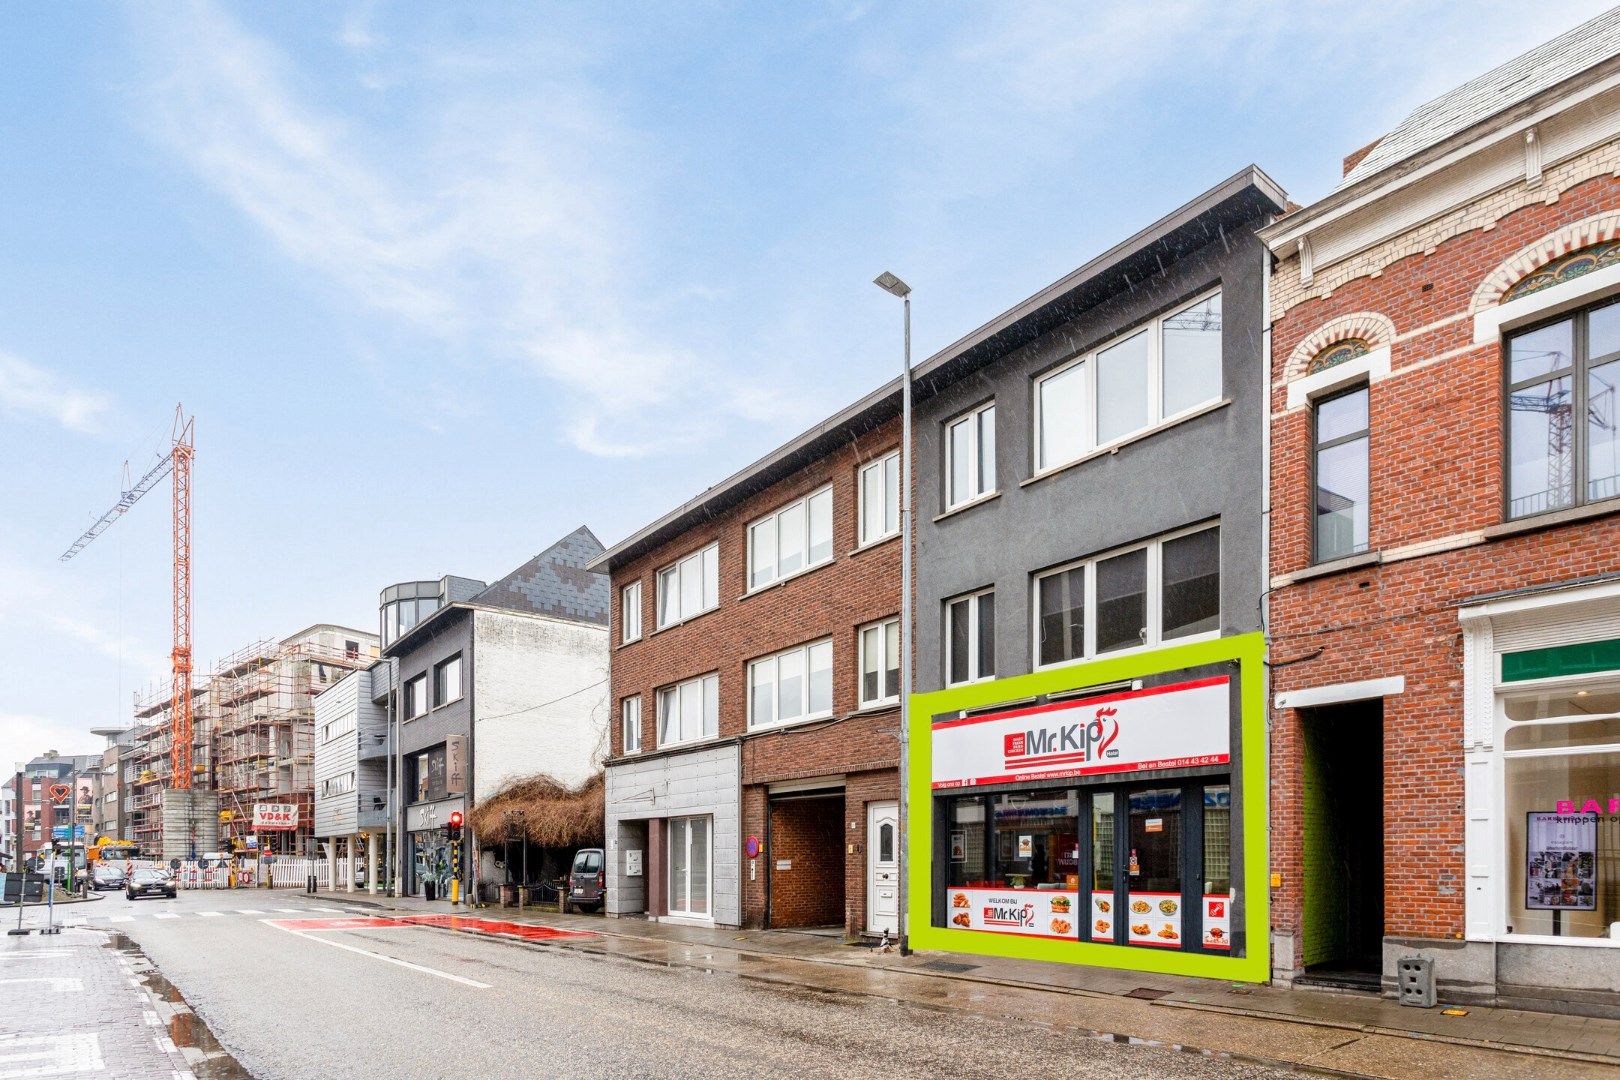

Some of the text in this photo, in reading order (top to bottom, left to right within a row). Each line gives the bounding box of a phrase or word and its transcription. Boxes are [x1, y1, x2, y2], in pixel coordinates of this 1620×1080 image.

[451, 741, 464, 787] Skiff
[1177, 758, 1189, 766] 014
[1191, 757, 1200, 765] 43
[259, 812, 291, 821] VD&K
[1556, 816, 1604, 825] knippen
